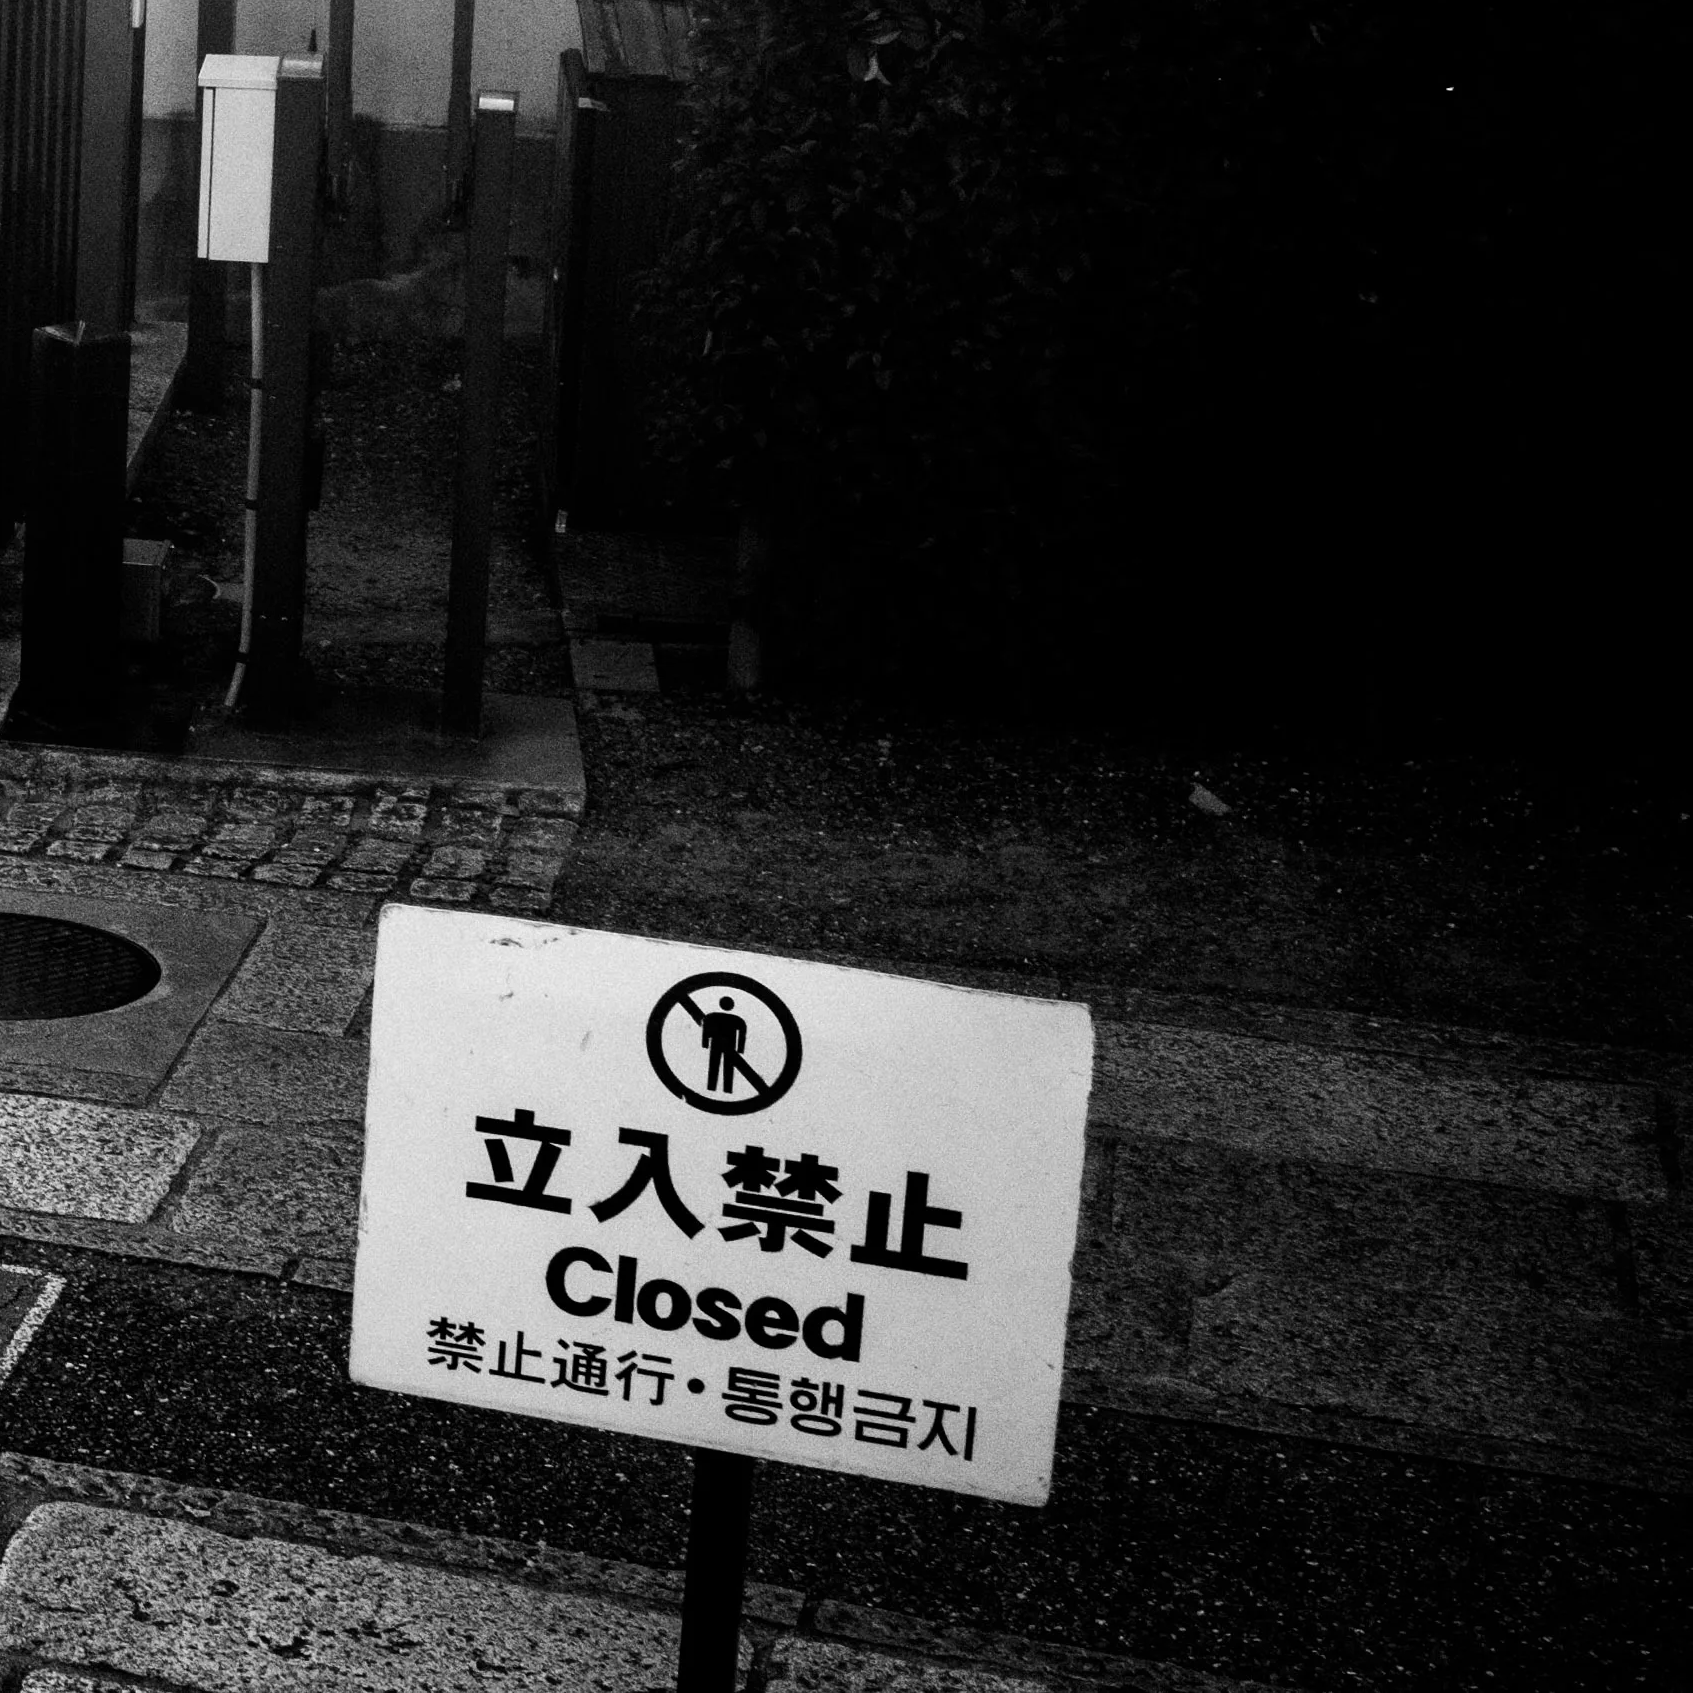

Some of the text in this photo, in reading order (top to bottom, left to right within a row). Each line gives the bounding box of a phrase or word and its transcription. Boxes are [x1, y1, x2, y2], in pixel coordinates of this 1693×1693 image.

[465, 1108, 969, 1281] 立入禁止
[545, 1246, 865, 1363] Closed
